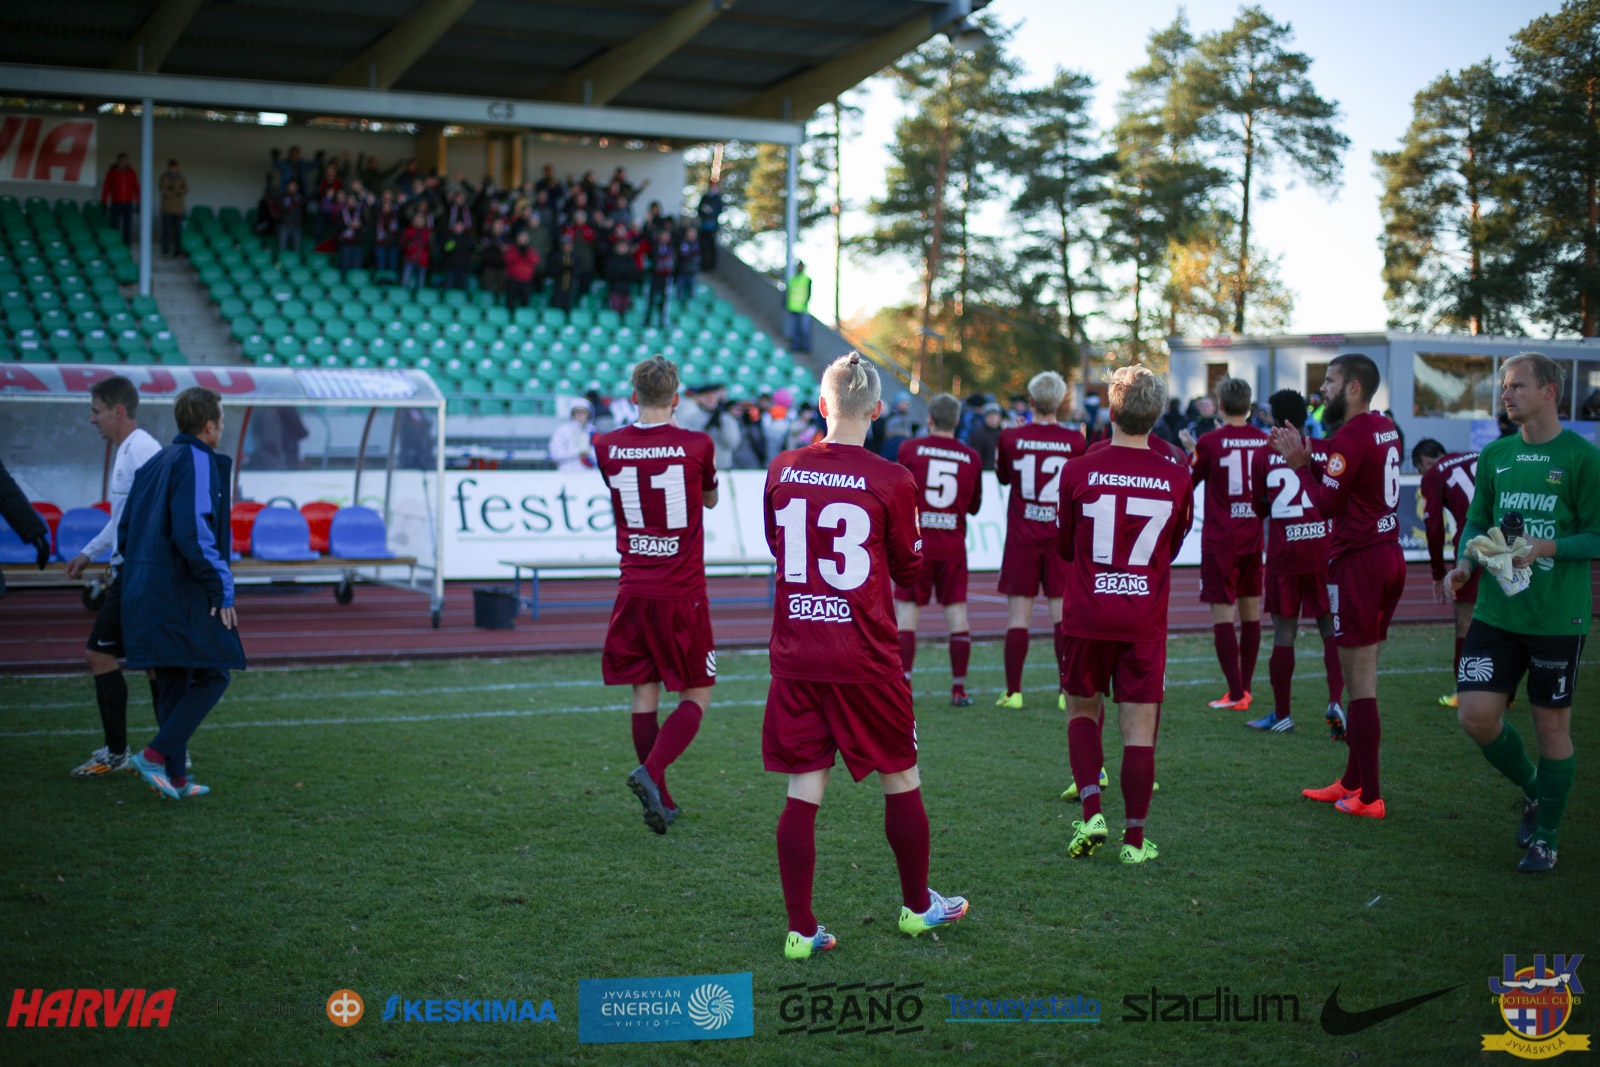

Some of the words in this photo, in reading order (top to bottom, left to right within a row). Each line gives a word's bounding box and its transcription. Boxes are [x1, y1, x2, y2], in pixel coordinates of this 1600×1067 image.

[617, 446, 686, 459] KESKIMAA
[1024, 440, 1072, 452] KESKIMAA
[1516, 453, 1550, 462] stadium
[789, 470, 866, 490] KESKIMAA
[1012, 454, 1069, 502] 12
[1219, 449, 1254, 495] 1
[1384, 446, 1400, 508] 6
[925, 459, 958, 509] 5
[1099, 474, 1170, 491] KESKIMAA
[1446, 466, 1478, 504] 1
[608, 464, 688, 529] 11
[1500, 491, 1558, 512] HARVIA
[1082, 494, 1173, 566] 17
[1286, 526, 1325, 538] GRANO
[629, 539, 679, 552] GRANO
[775, 498, 870, 591] 13
[1095, 577, 1148, 591] GRANO
[789, 598, 850, 617] GRANO
[1558, 676, 1566, 693] 1
